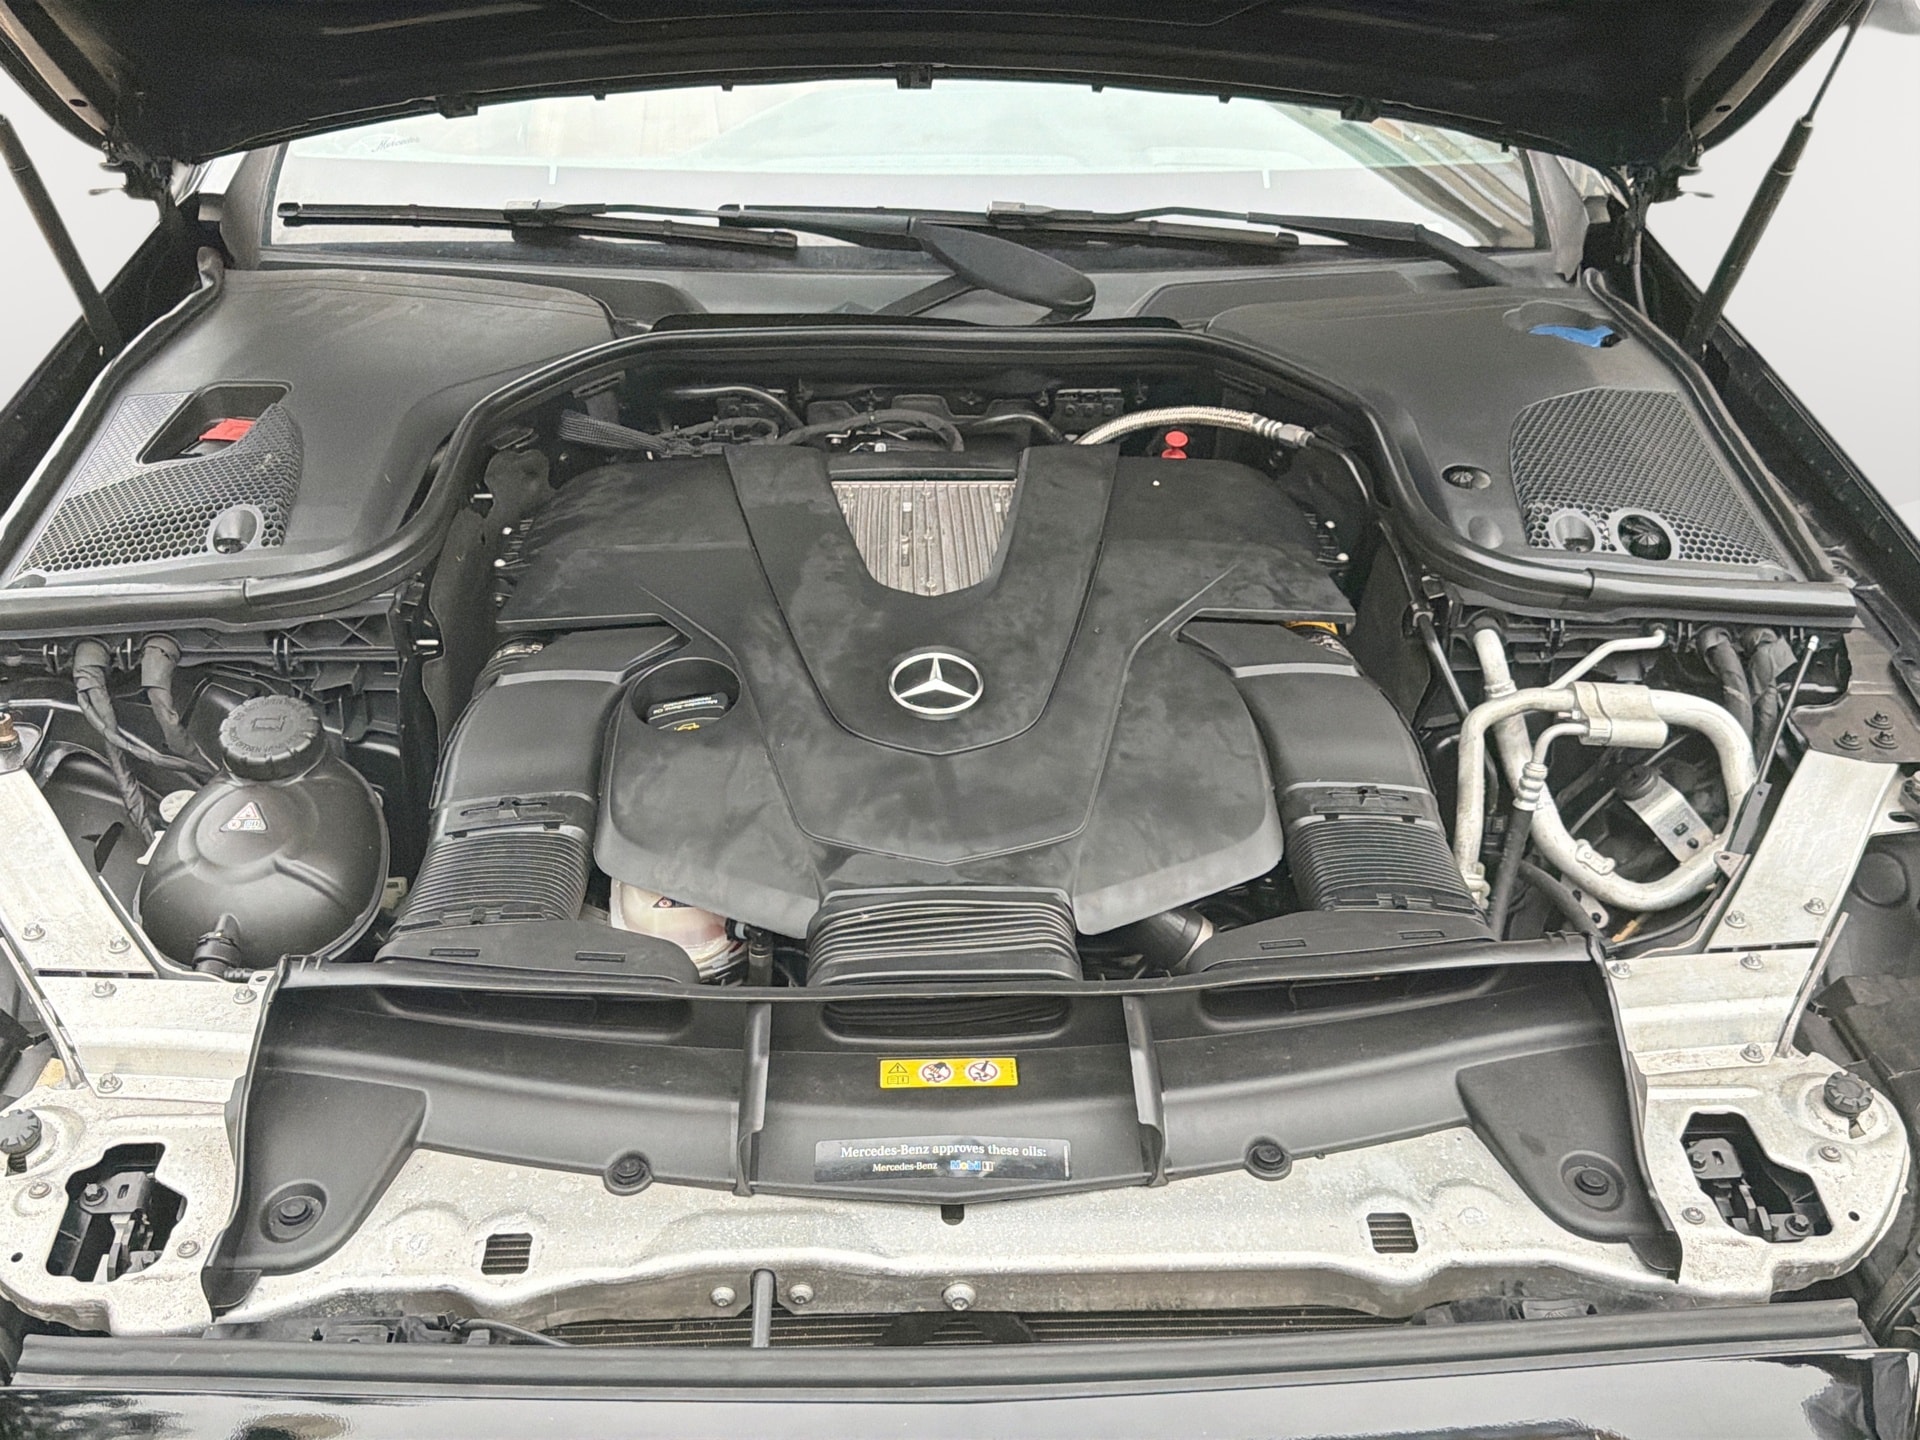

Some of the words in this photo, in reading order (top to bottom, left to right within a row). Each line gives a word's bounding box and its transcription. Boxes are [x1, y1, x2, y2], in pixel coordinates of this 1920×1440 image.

[841, 1144, 929, 1158] Mercedes-Benz
[932, 1144, 985, 1156] approves
[988, 1144, 1019, 1156] these
[1022, 1146, 1047, 1157] oils:
[872, 1162, 938, 1172] Mercedes-Benz
[950, 1160, 981, 1171] Mobil
